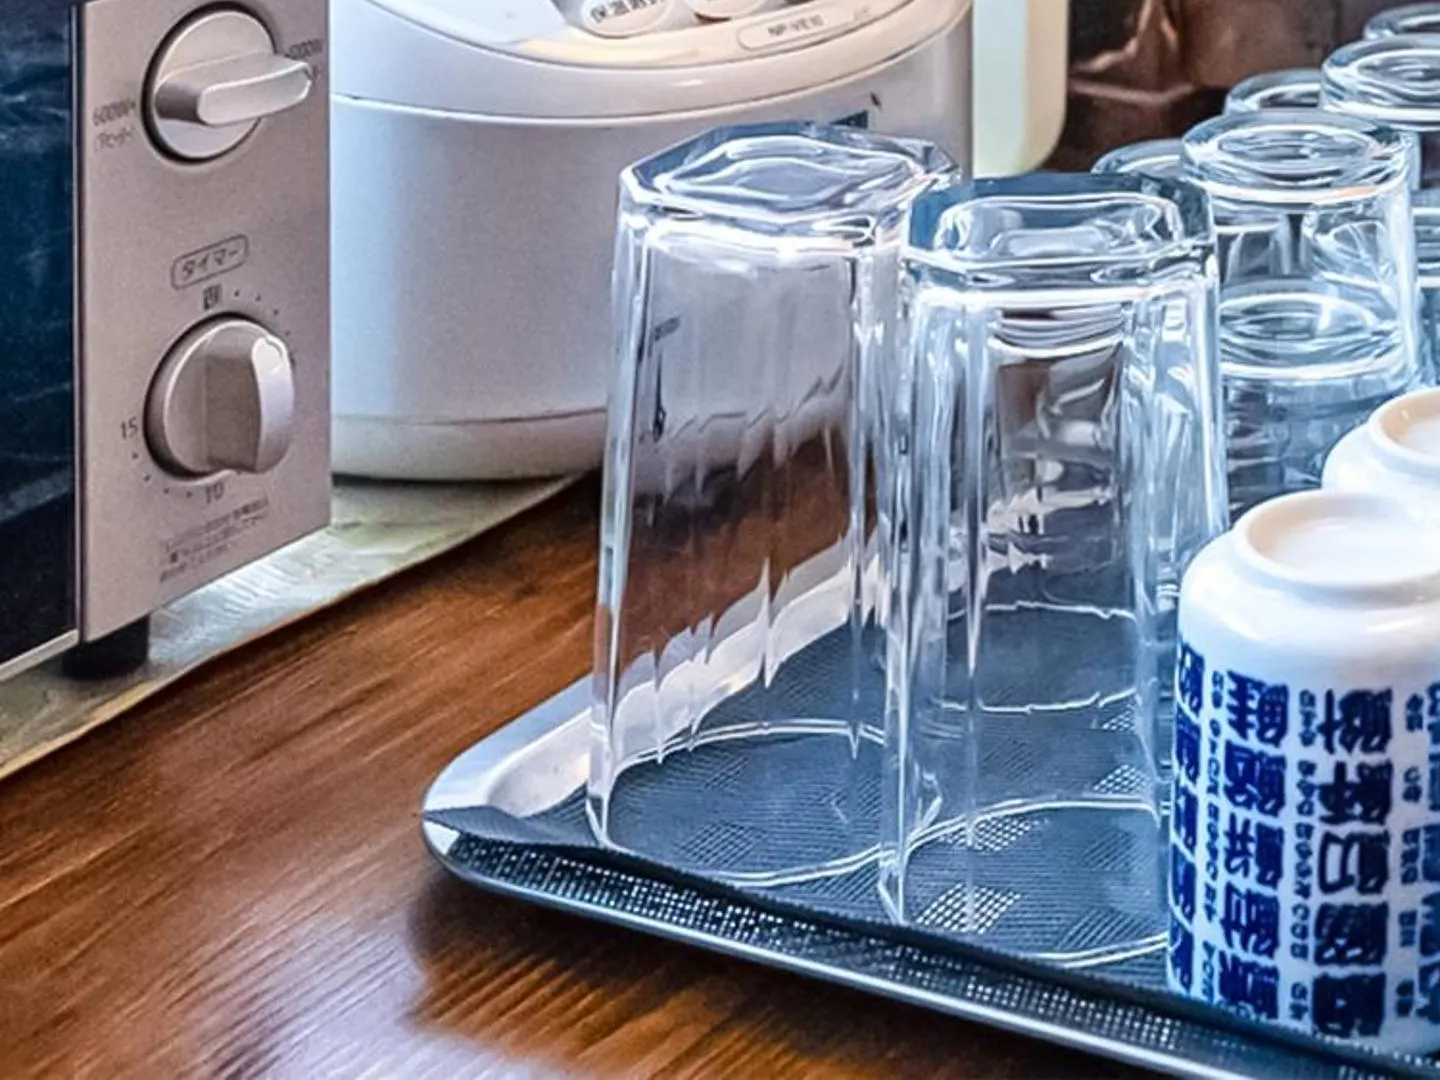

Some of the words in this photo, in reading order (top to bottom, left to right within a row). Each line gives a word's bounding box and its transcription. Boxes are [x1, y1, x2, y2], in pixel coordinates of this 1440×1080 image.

[182, 248, 239, 282] タイマー
[120, 416, 139, 440] 15
[205, 480, 225, 505] 10
